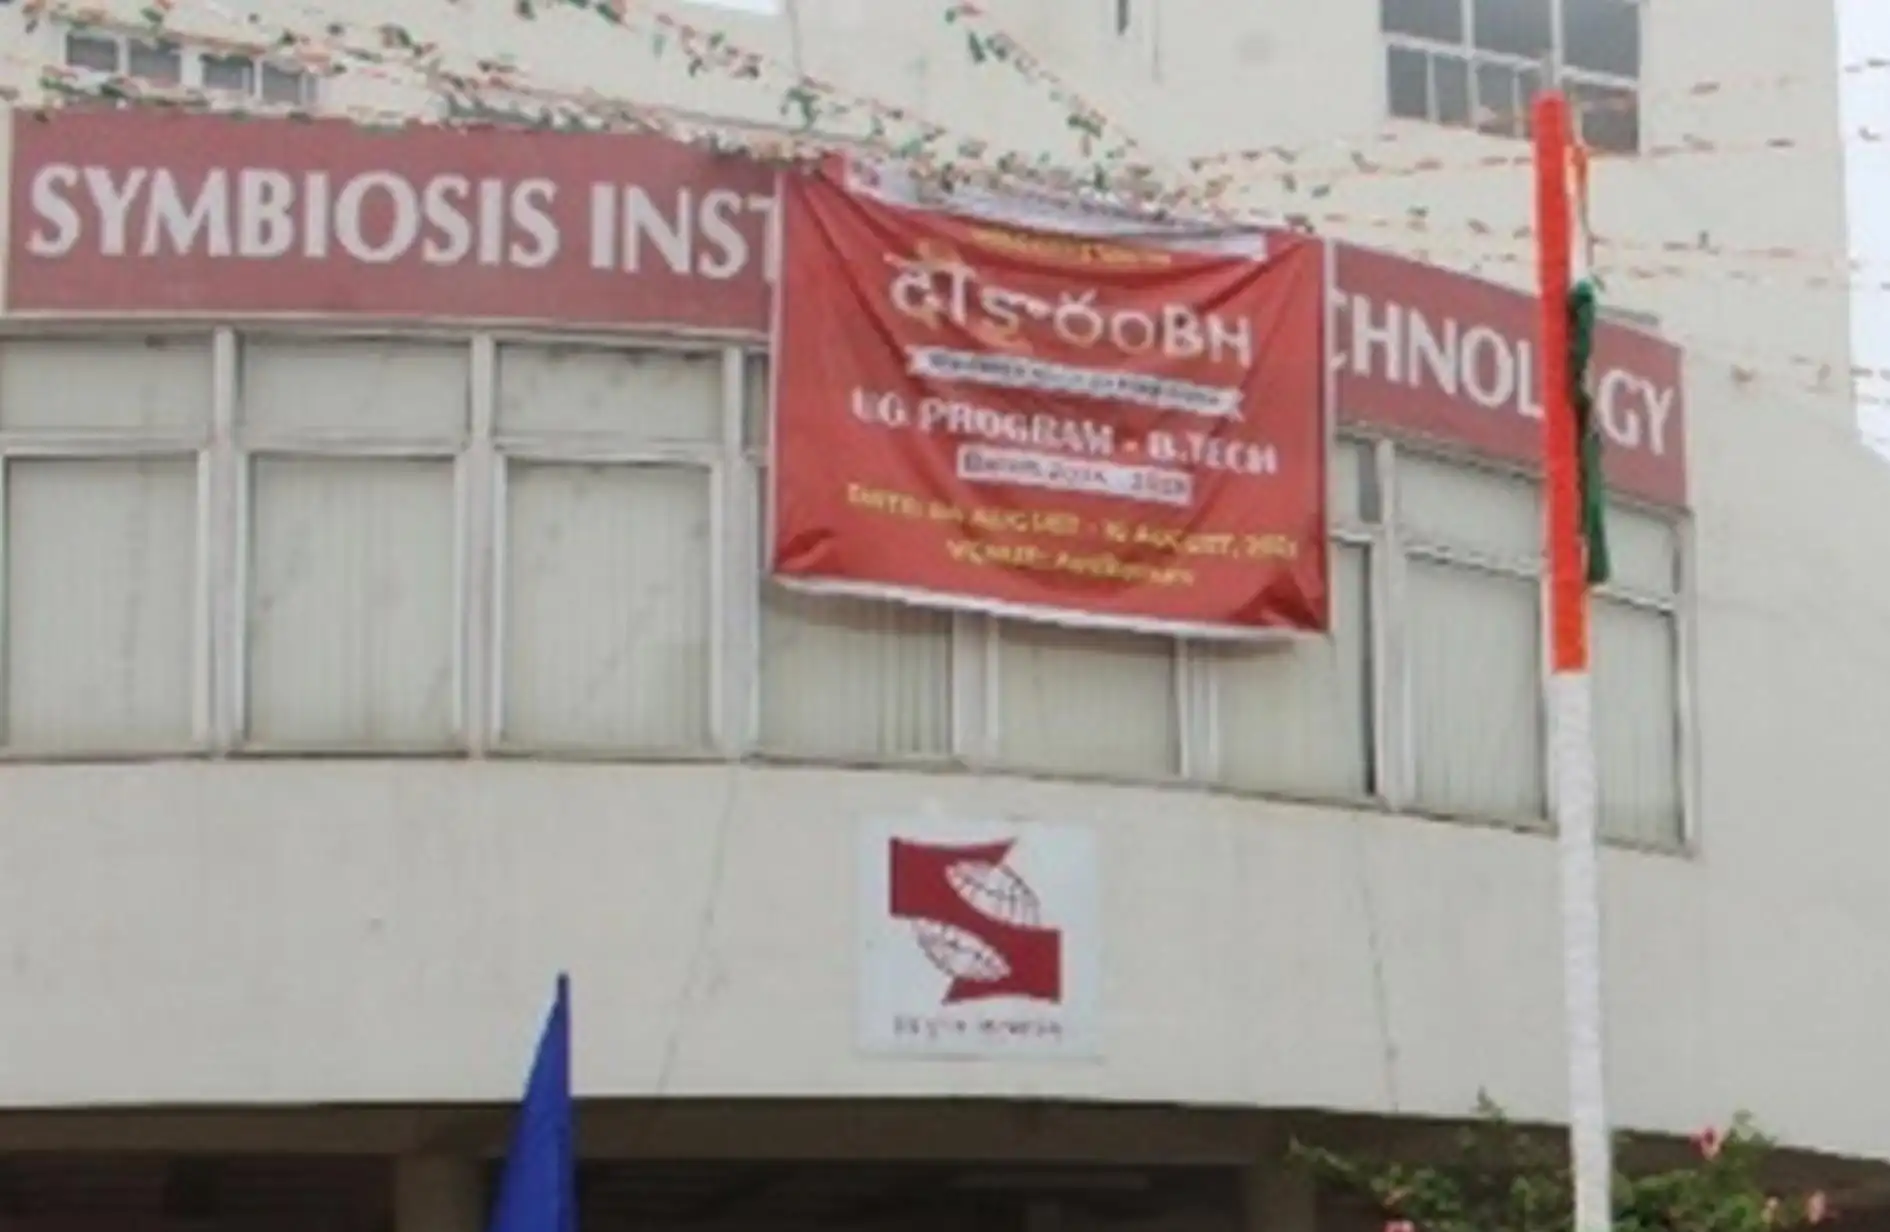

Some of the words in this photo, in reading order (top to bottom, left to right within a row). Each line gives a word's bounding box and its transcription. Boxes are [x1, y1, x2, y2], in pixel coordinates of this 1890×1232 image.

[25, 162, 560, 269] SYMBIOSIS
[1333, 285, 1673, 455] HNOLGY
[917, 397, 1114, 456] PROGRAM
[1148, 430, 1278, 475] B.TECH
